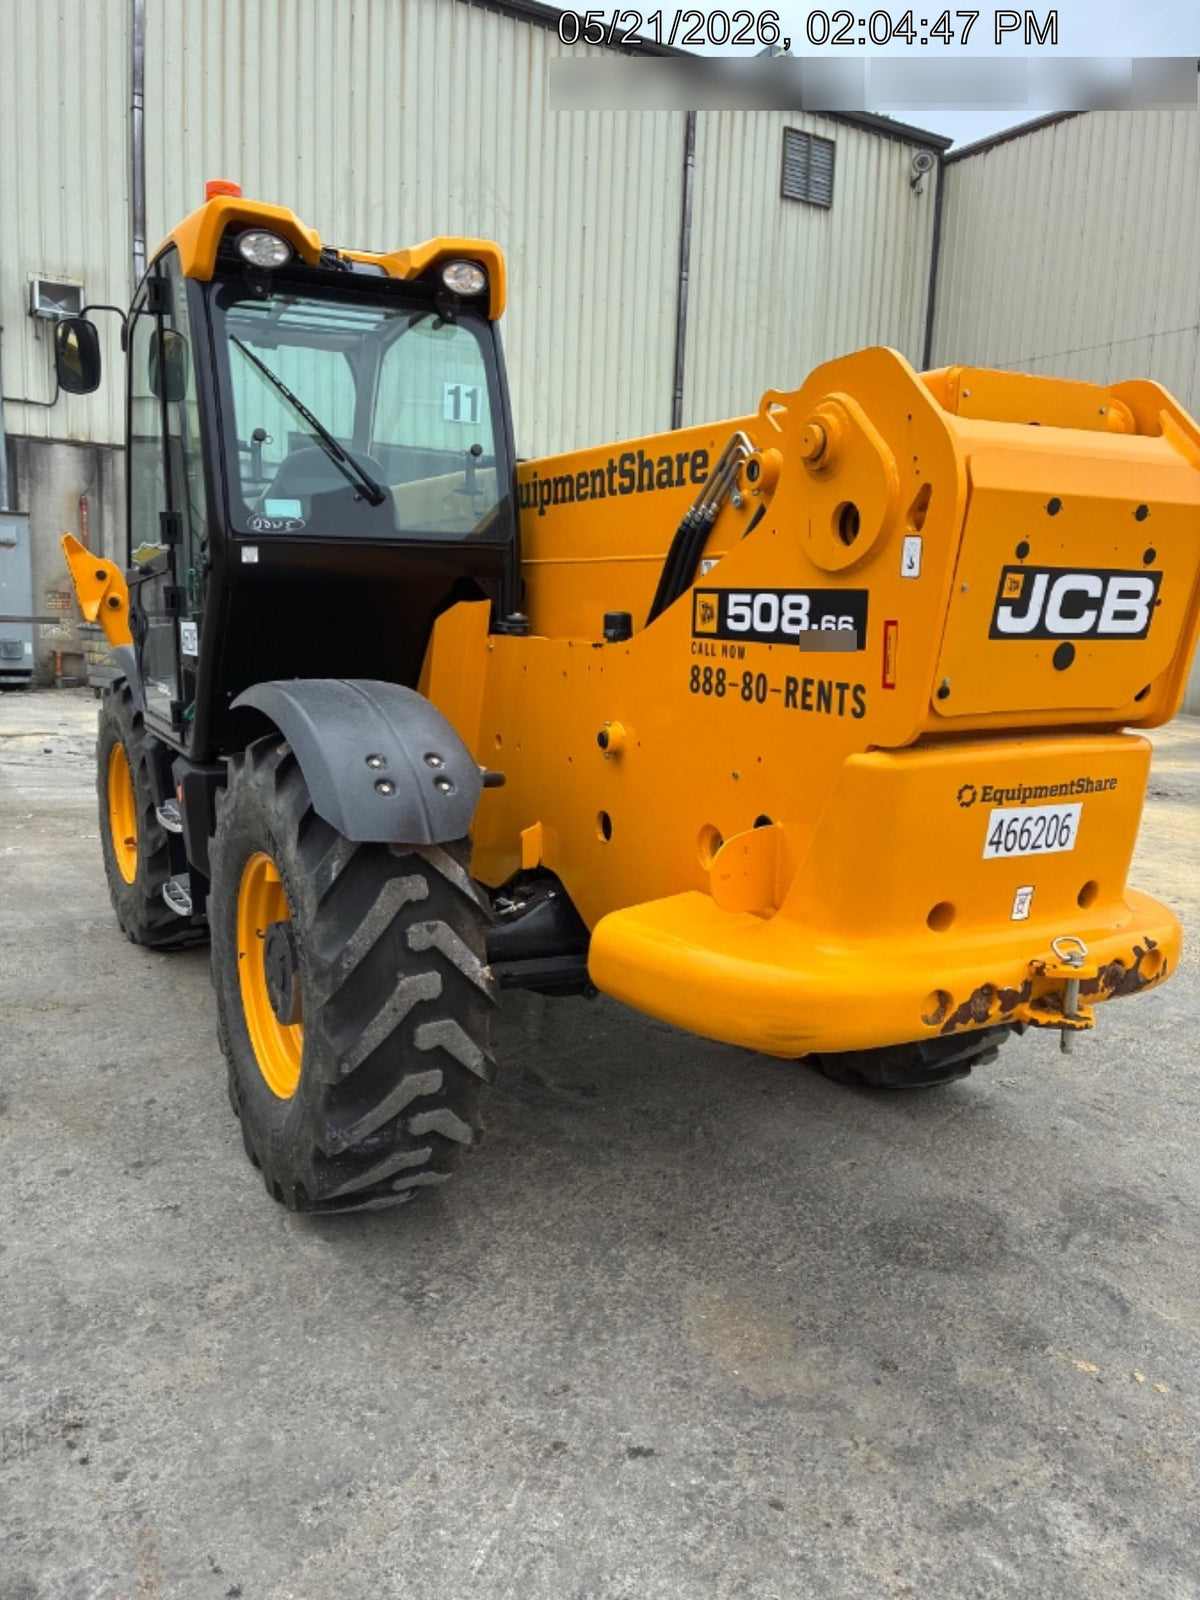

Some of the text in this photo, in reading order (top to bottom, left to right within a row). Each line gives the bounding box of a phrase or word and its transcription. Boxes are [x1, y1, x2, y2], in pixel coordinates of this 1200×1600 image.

[447, 385, 478, 422] 11
[518, 448, 708, 516] uipmentShare
[996, 573, 1155, 634] JCB
[690, 640, 746, 660] CALL NOW
[689, 664, 867, 719] 888-80-RENTS
[980, 777, 1118, 806] EquipmentShare
[988, 813, 1073, 853] 466206
